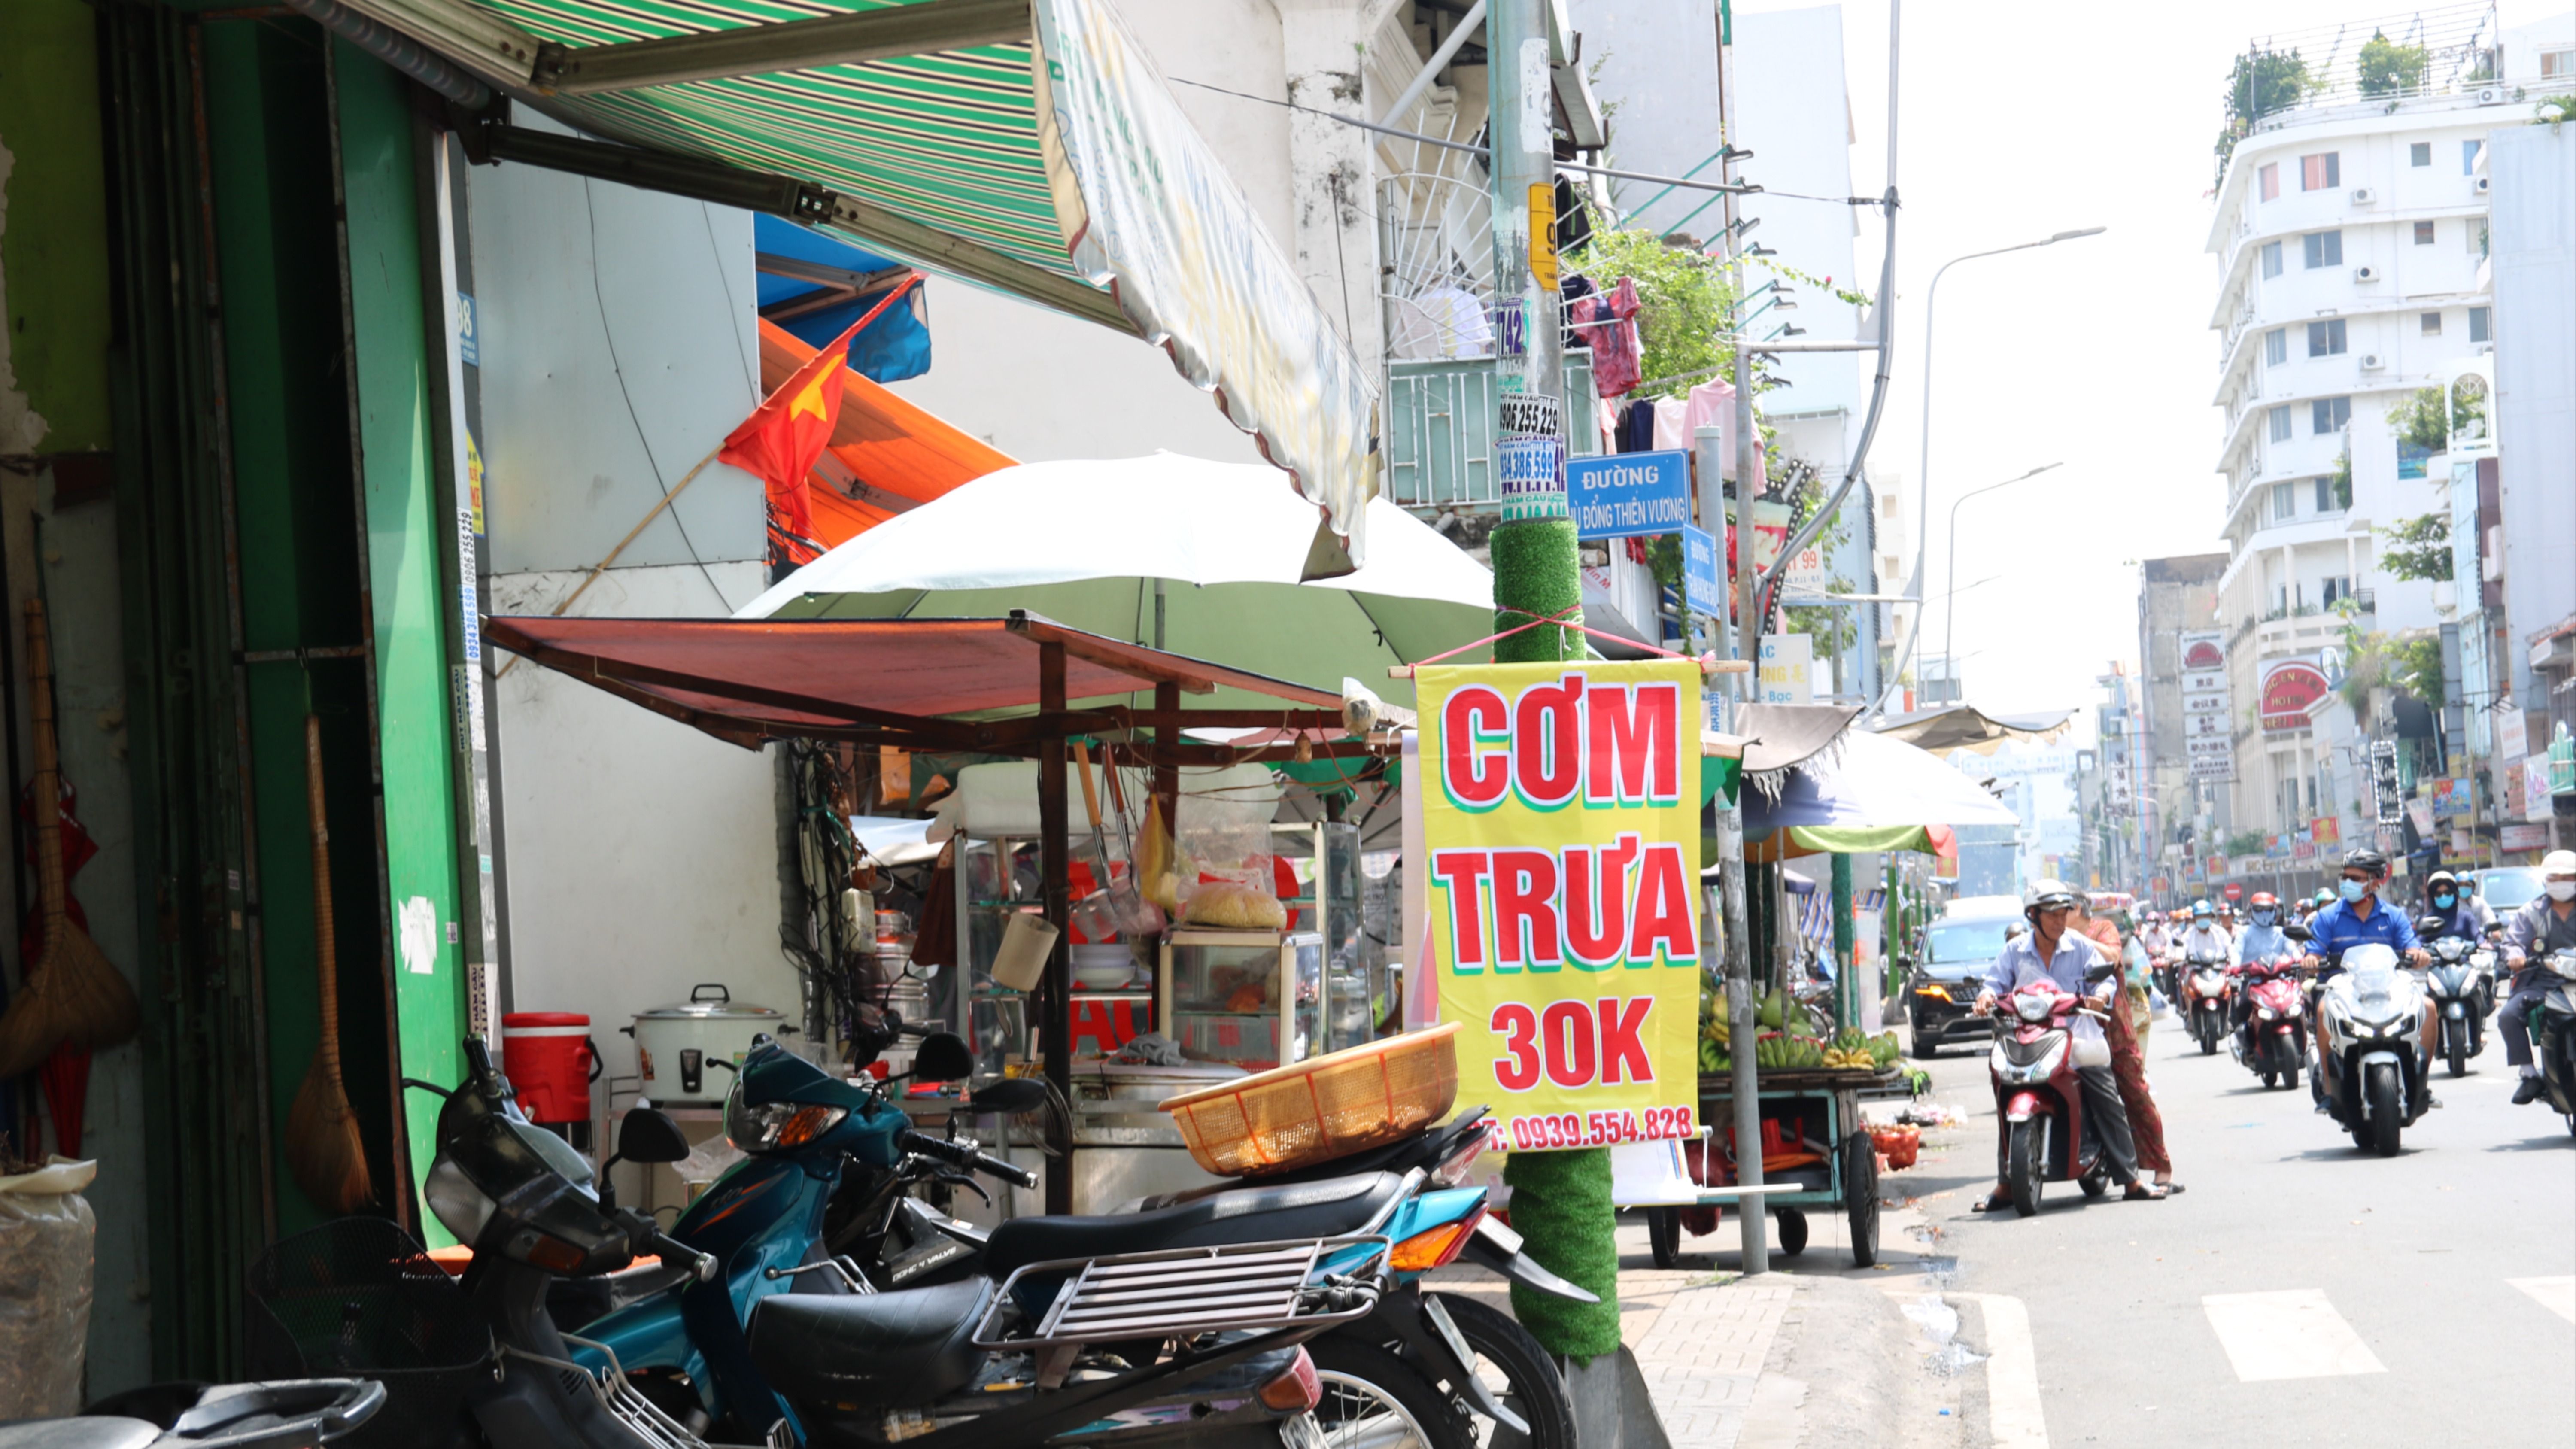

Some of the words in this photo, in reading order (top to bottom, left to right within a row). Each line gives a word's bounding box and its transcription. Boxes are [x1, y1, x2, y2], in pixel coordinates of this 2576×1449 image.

[1581, 465, 1659, 490] ĐƯỜNG
[1583, 494, 1613, 530] ĐỔNG
[1648, 497, 1686, 523] VƯƠNG
[1801, 550, 1817, 570] 99
[1768, 690, 1792, 704] Bạc
[1440, 671, 1681, 813] CƠM
[1431, 831, 1699, 975] TRƯA
[1490, 996, 1656, 1094] 30K
[1511, 1106, 1693, 1151] 0939.554.828
[893, 1263, 917, 1283] DOHC
[918, 1260, 925, 1268] 4
[927, 1245, 957, 1264] VALVE
